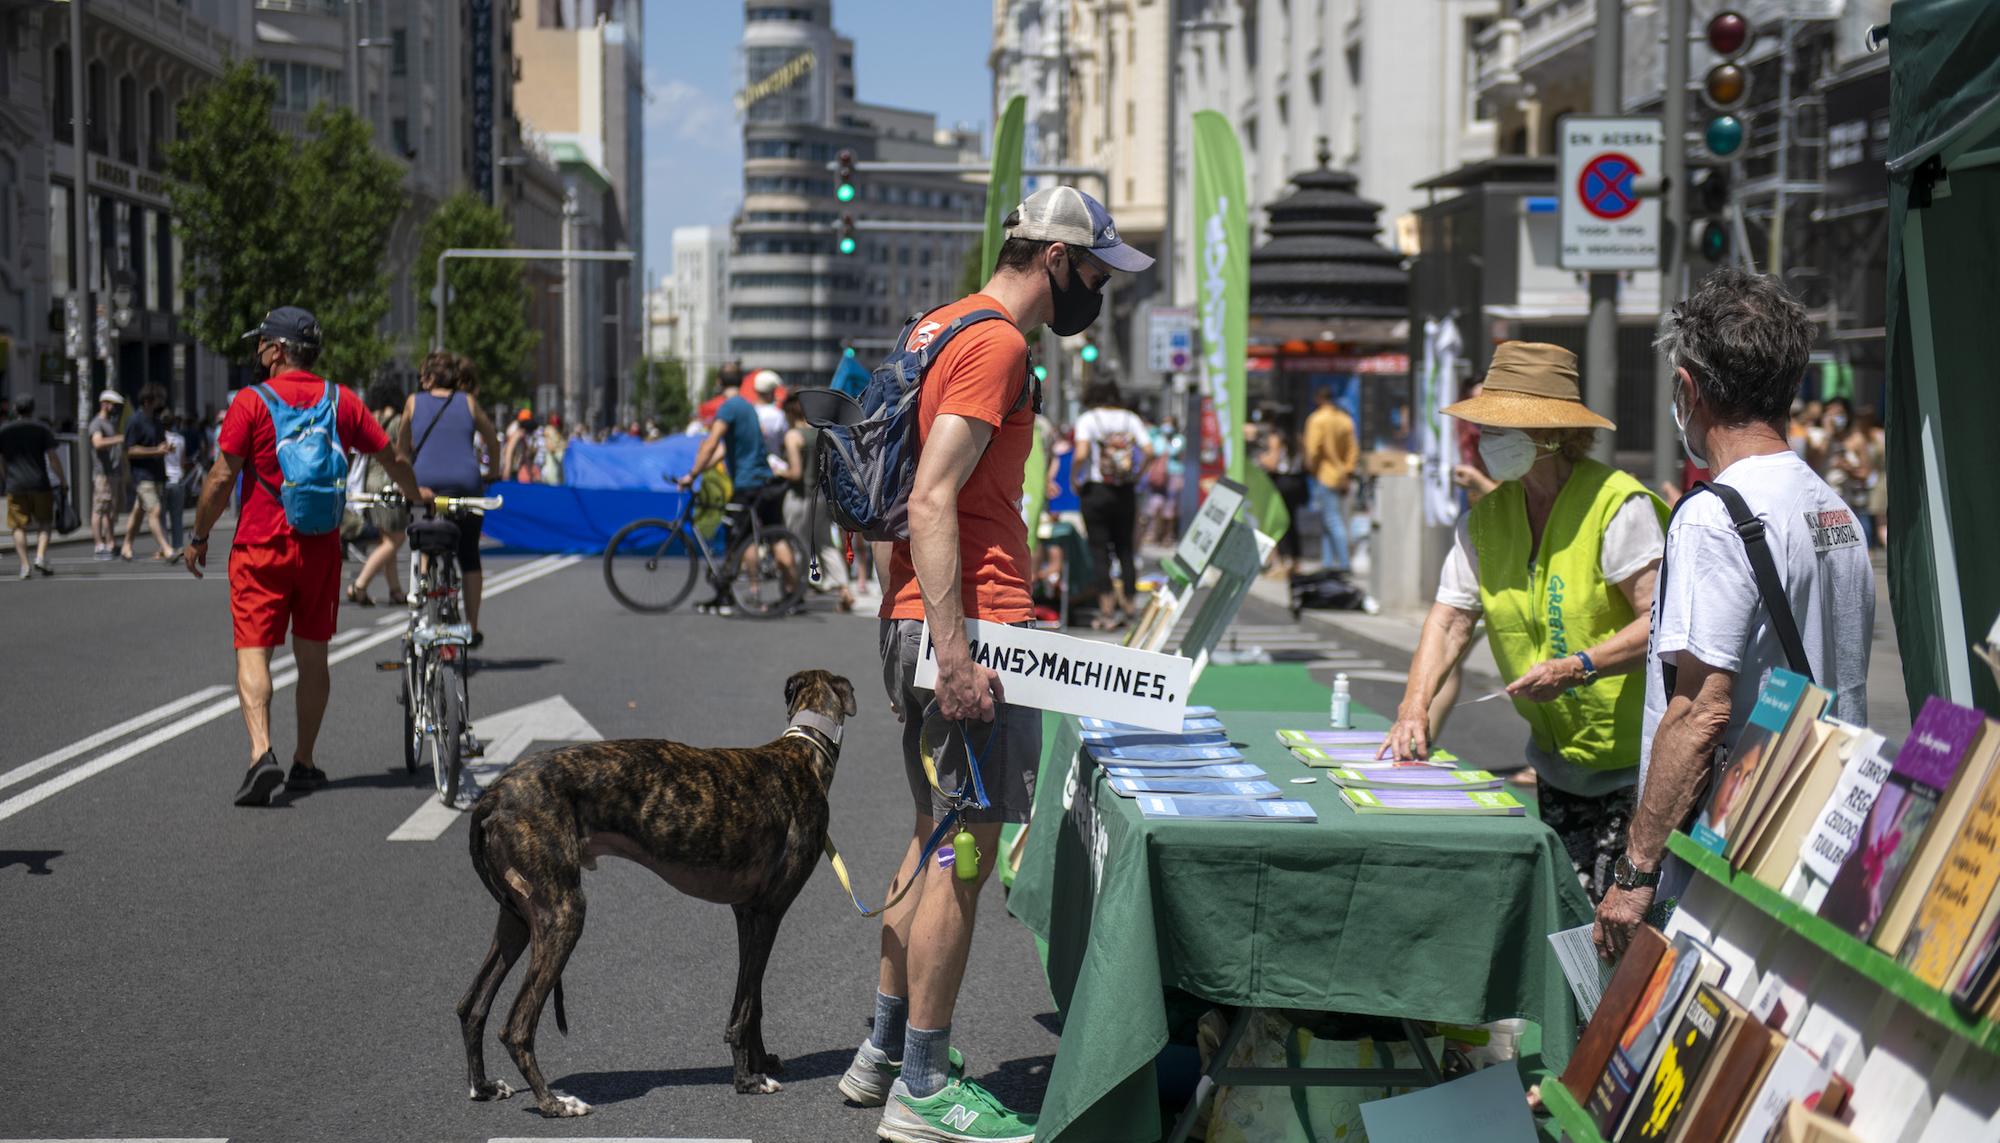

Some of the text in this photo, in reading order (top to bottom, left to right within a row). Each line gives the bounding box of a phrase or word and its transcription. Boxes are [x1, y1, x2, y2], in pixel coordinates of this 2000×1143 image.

[1570, 132, 1654, 146] EN ACERA
[1831, 525, 1859, 545] CRISTAL
[941, 1103, 980, 1132] N
